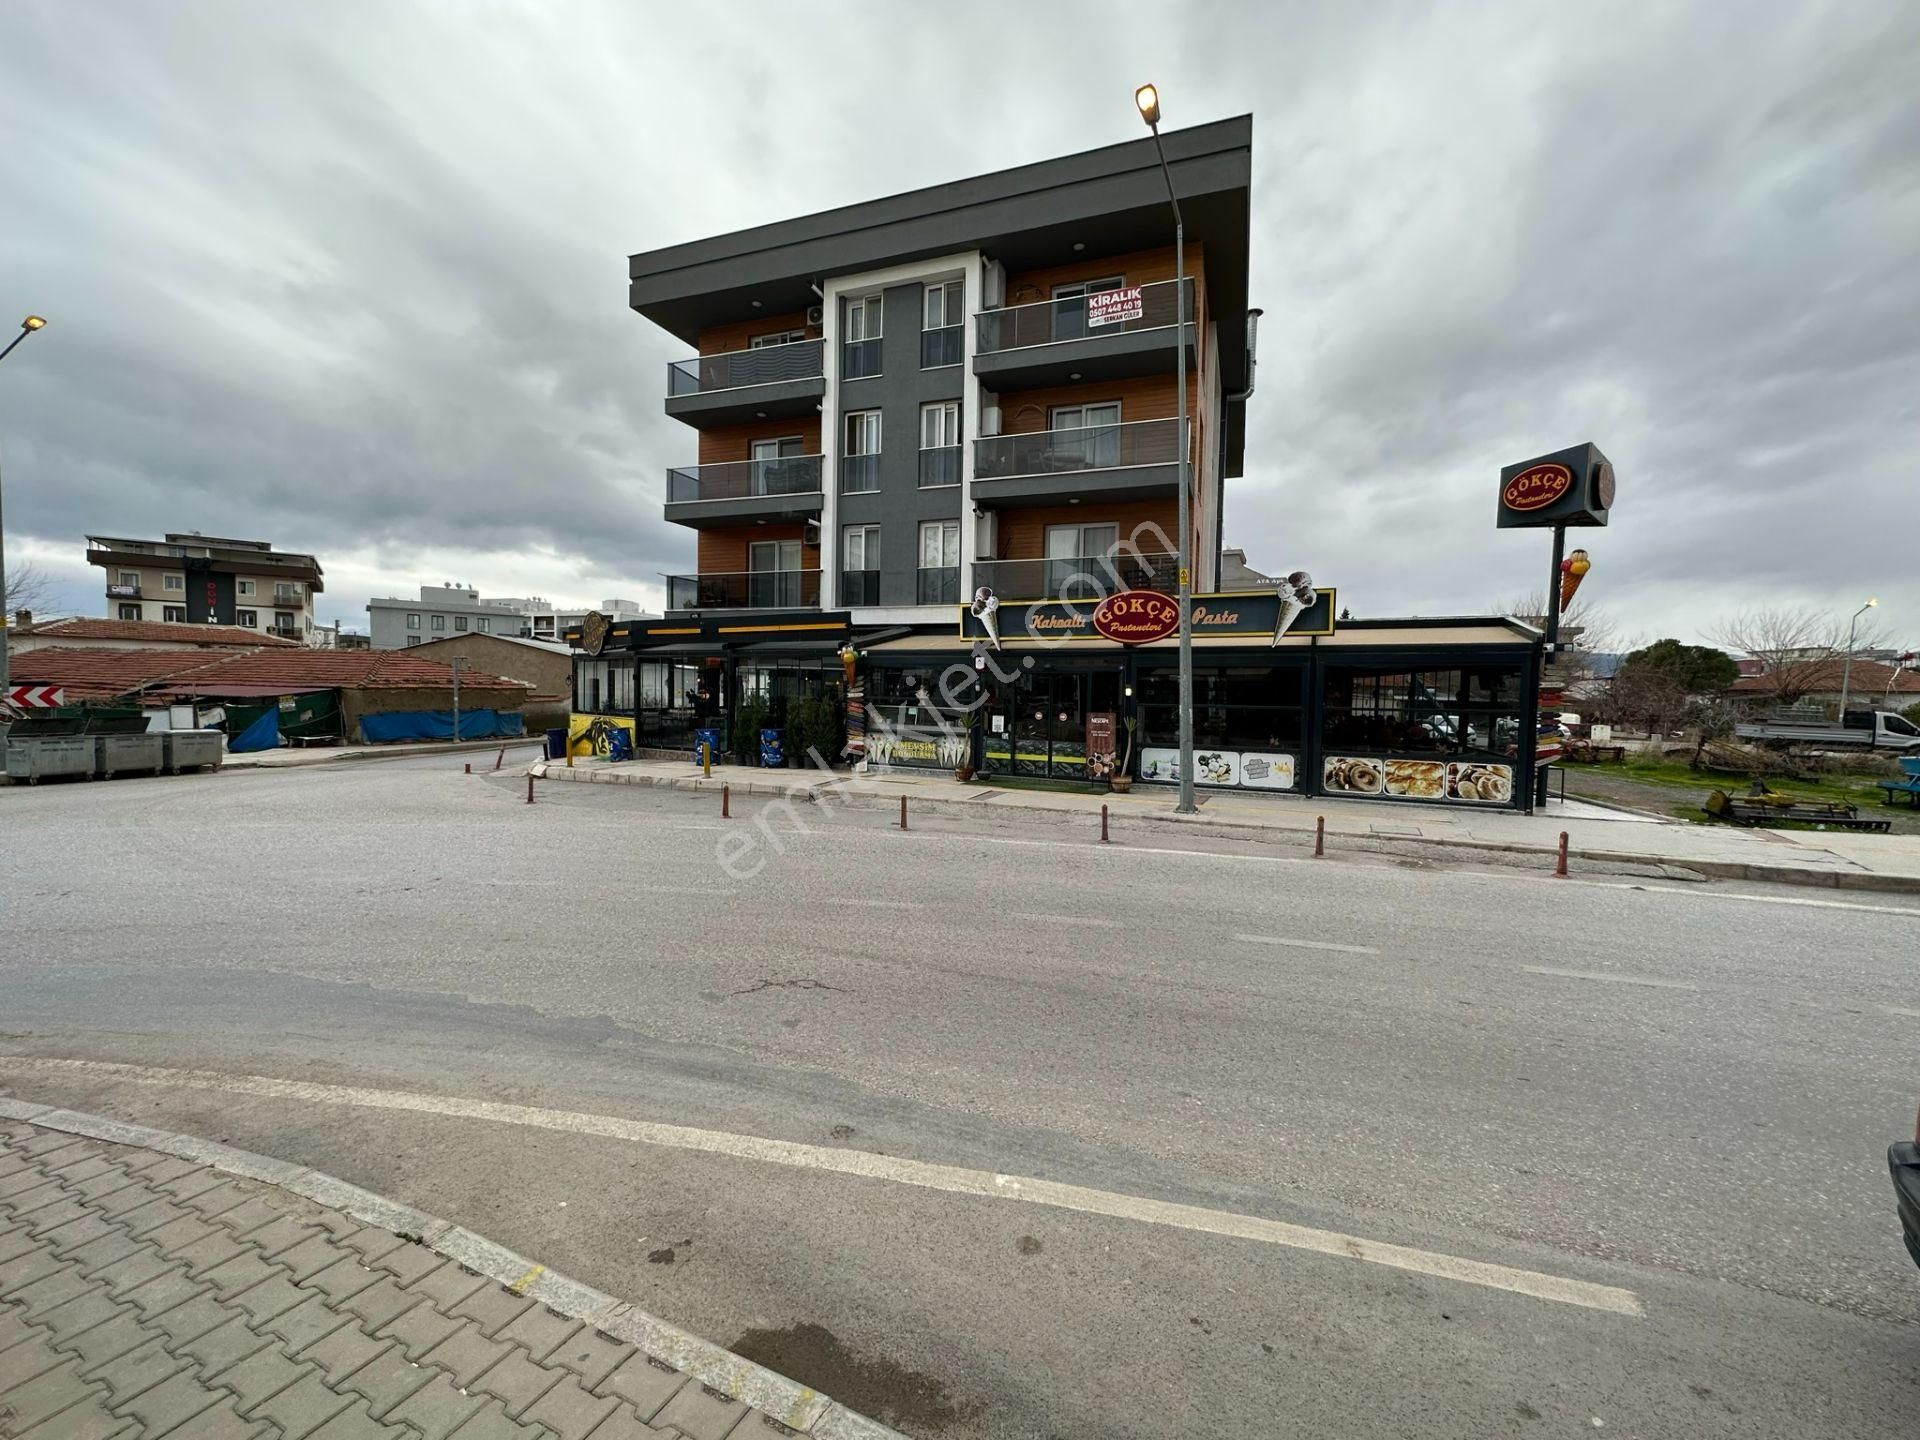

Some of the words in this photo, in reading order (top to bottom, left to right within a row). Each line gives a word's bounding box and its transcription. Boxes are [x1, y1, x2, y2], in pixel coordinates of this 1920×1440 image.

[1089, 288, 1141, 308] KİRALIK
[1089, 307, 1106, 317] 0507
[1108, 304, 1121, 313] 448
[1123, 302, 1133, 310] 40
[1134, 300, 1141, 308] 19
[1506, 473, 1566, 500] GÖKÇE
[1098, 598, 1176, 624] GÖKÇE
[1192, 606, 1239, 625] Pasta
